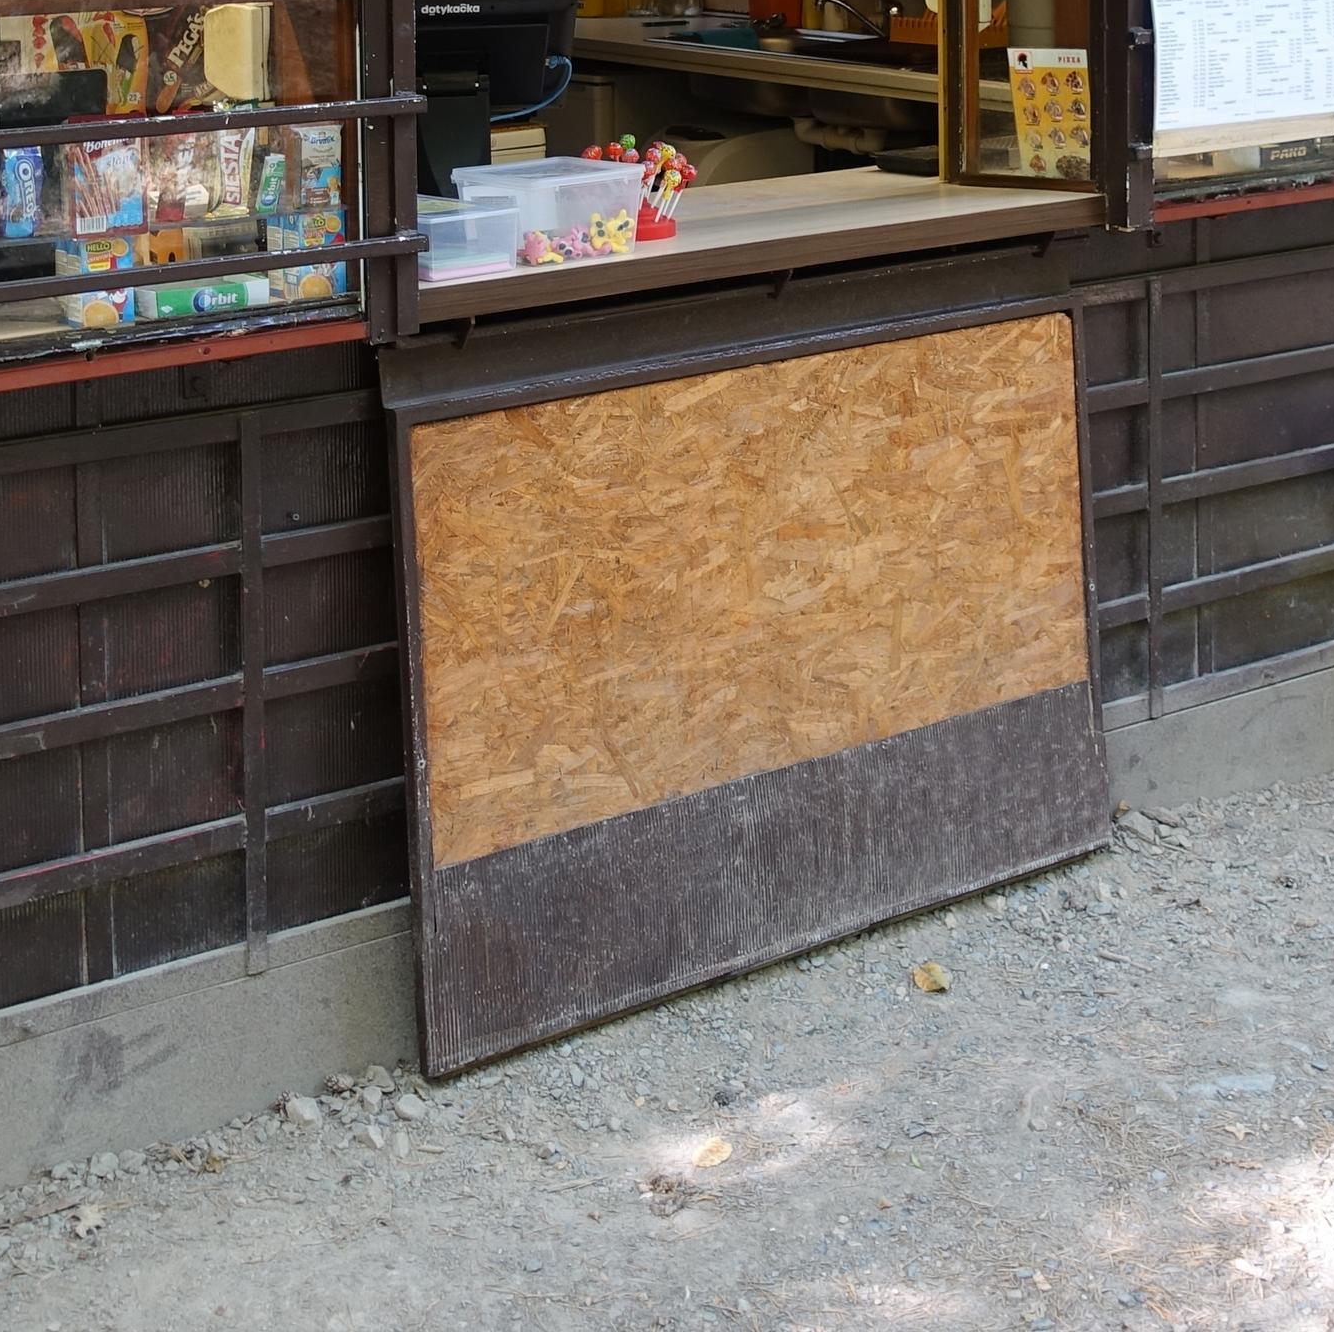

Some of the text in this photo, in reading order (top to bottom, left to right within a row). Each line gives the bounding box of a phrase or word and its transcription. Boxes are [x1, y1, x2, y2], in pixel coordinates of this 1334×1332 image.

[421, 3, 481, 16] dotykačka
[221, 132, 243, 205] SIESTA
[17, 159, 37, 219] OREO
[261, 177, 278, 206] Orbit
[87, 242, 110, 252] HELLO
[192, 288, 239, 313] Orbit
